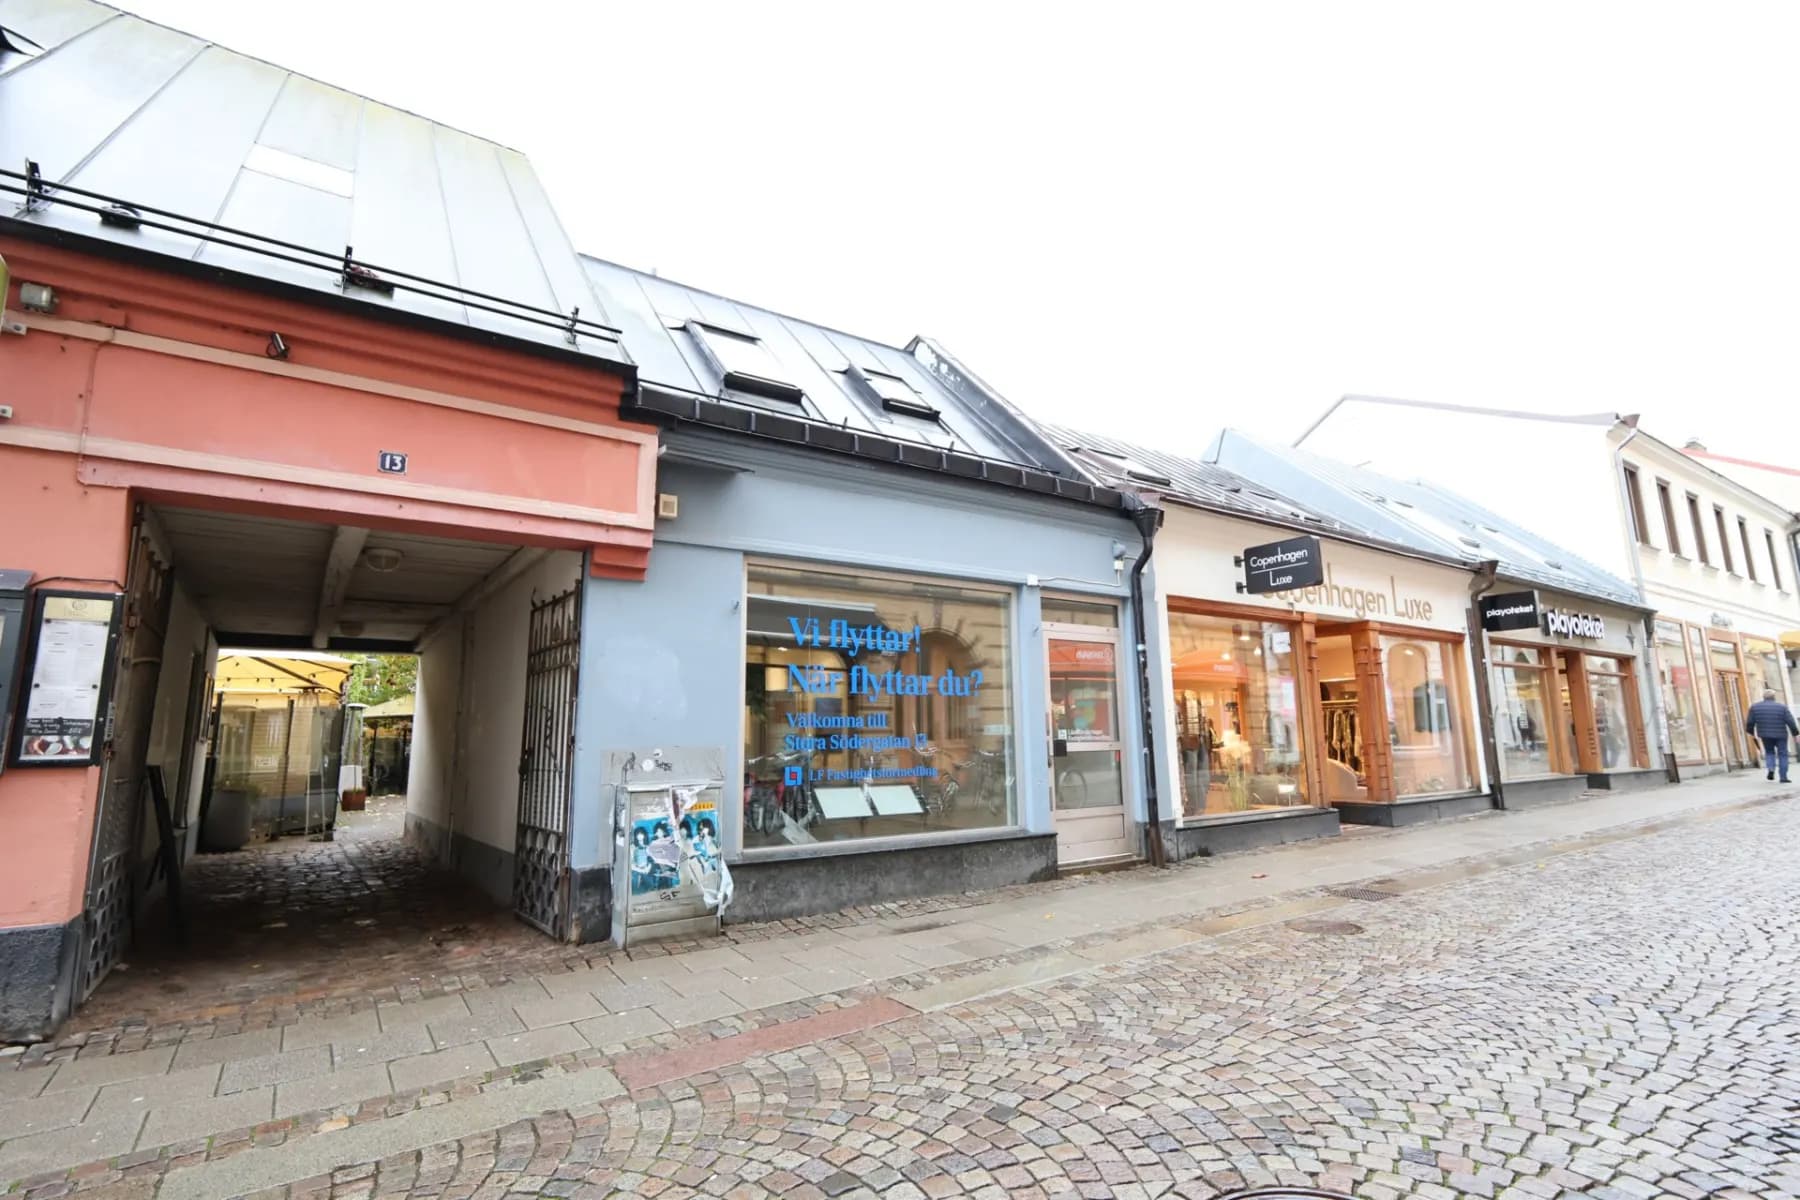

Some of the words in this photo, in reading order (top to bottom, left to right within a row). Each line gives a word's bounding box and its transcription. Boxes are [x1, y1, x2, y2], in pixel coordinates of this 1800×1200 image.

[384, 454, 403, 471] 13
[1250, 546, 1309, 569] Copenhagen
[1269, 571, 1293, 587] Luxe
[1390, 575, 1433, 622] Luxe
[1486, 604, 1534, 619] playoteket
[1546, 609, 1605, 640] playoteket
[787, 616, 821, 648] Vi
[828, 618, 922, 657] flyttar!
[787, 663, 844, 695] När
[849, 664, 934, 703] flyttar
[937, 668, 985, 697] du?
[785, 711, 865, 729] Välkomna
[867, 711, 888, 729] till
[784, 733, 827, 751] Stora
[830, 733, 912, 752] Södergatan
